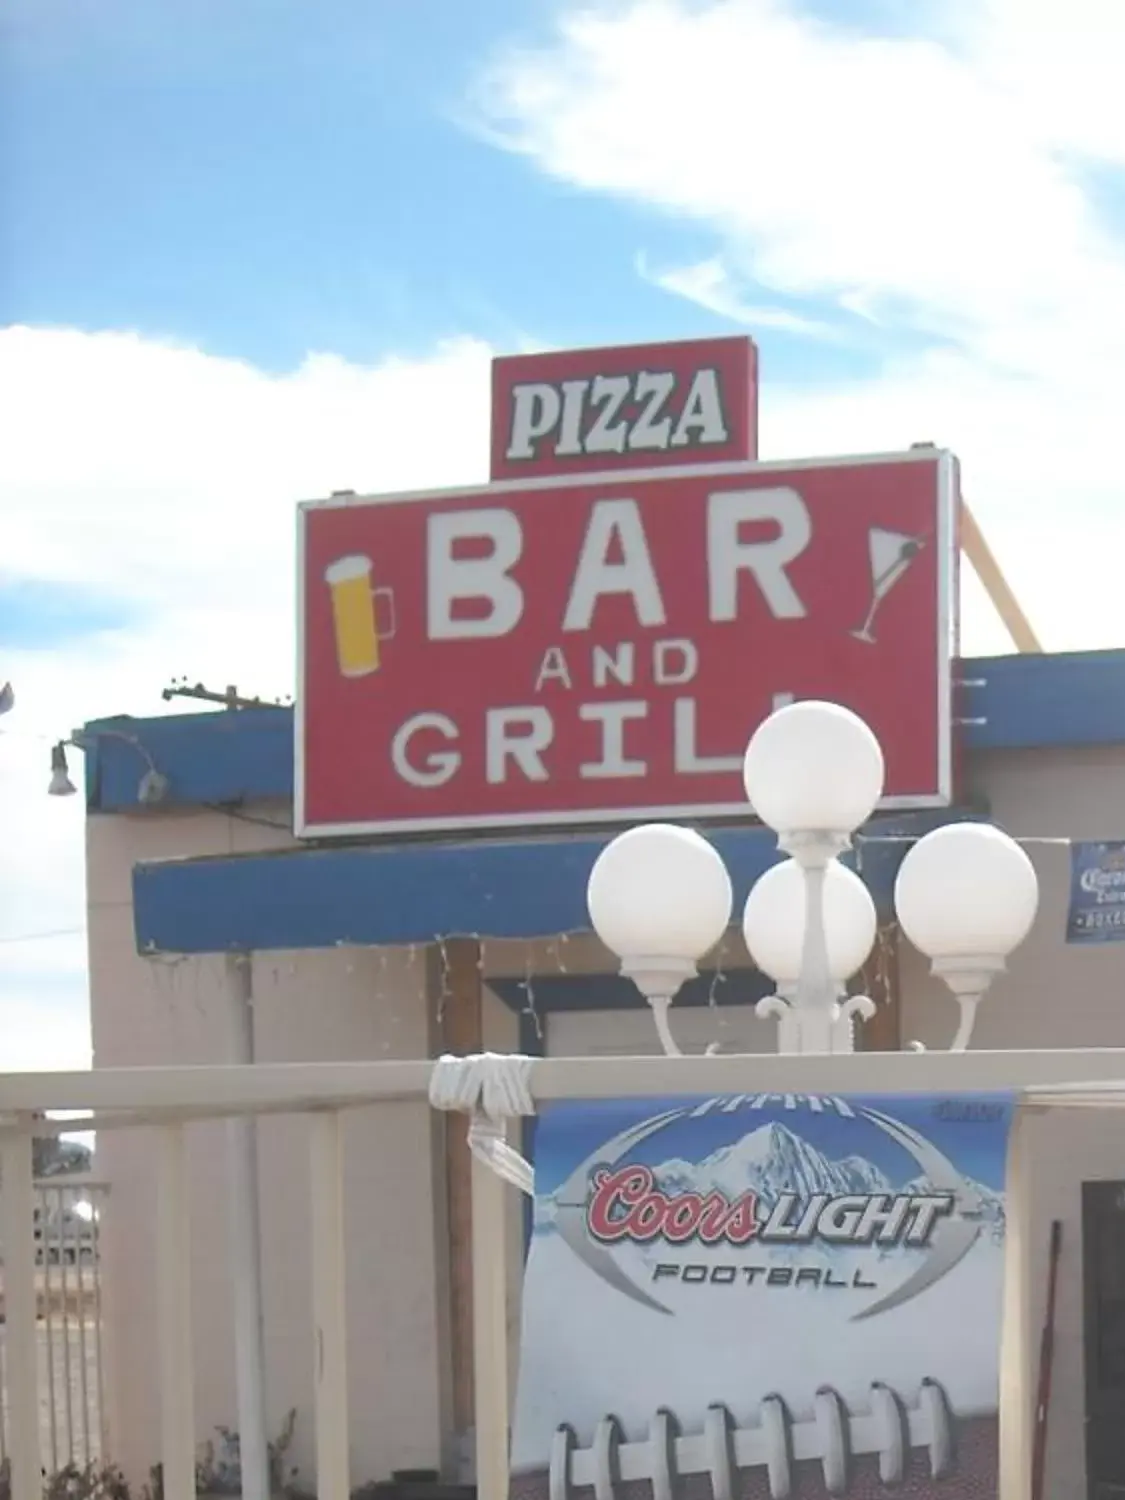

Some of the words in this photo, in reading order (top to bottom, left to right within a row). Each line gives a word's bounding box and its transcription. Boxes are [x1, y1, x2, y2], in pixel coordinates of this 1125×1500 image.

[506, 368, 728, 459] PIZZA
[427, 486, 812, 640] BAR
[535, 638, 698, 692] AND
[392, 692, 795, 788] GRIL
[588, 1163, 762, 1244] Coors
[757, 1190, 955, 1246] LIGHT
[651, 1263, 879, 1289] FOOTBALL
